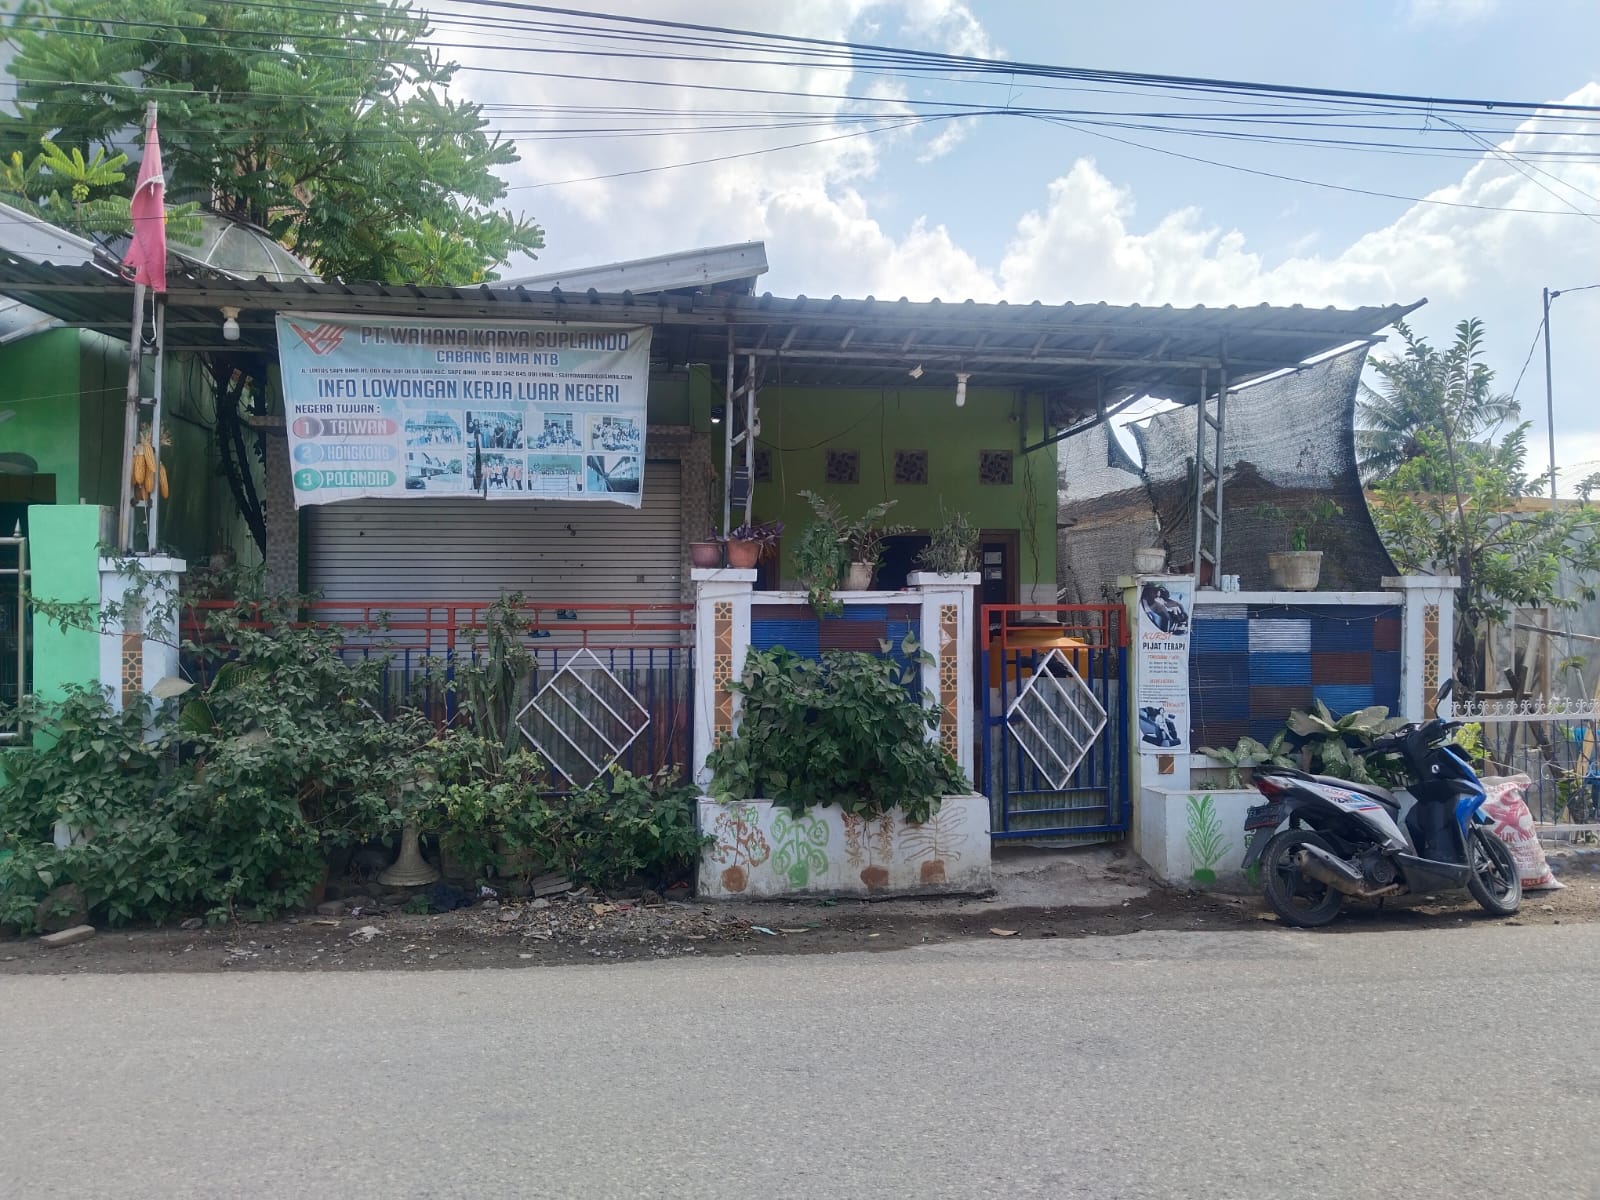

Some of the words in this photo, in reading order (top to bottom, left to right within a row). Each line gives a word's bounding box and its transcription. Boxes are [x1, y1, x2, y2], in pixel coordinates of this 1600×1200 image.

[361, 326, 385, 344] PT.
[389, 327, 468, 346] WAHANA
[474, 330, 530, 348] KARYA
[535, 332, 629, 351] SUPLAINDO
[436, 350, 492, 364] CABANG
[495, 351, 529, 365] BIMA
[533, 353, 559, 366] NTB
[318, 379, 357, 398] INFO
[362, 379, 458, 400] LOWONGAN
[463, 380, 513, 401] KERJA
[518, 382, 560, 401] LUAR
[565, 383, 620, 402] NEGERI
[295, 404, 333, 414] NEGERA
[336, 404, 375, 414] TUJUAN
[303, 421, 311, 434] 1
[329, 419, 388, 435] TAIWAN
[301, 446, 313, 459] 2
[326, 445, 390, 461] HONGKONG
[302, 473, 313, 487] 3
[325, 471, 390, 487] POLANDIA
[1142, 642, 1162, 650] PIJAT
[1164, 642, 1186, 651] TERAPI
